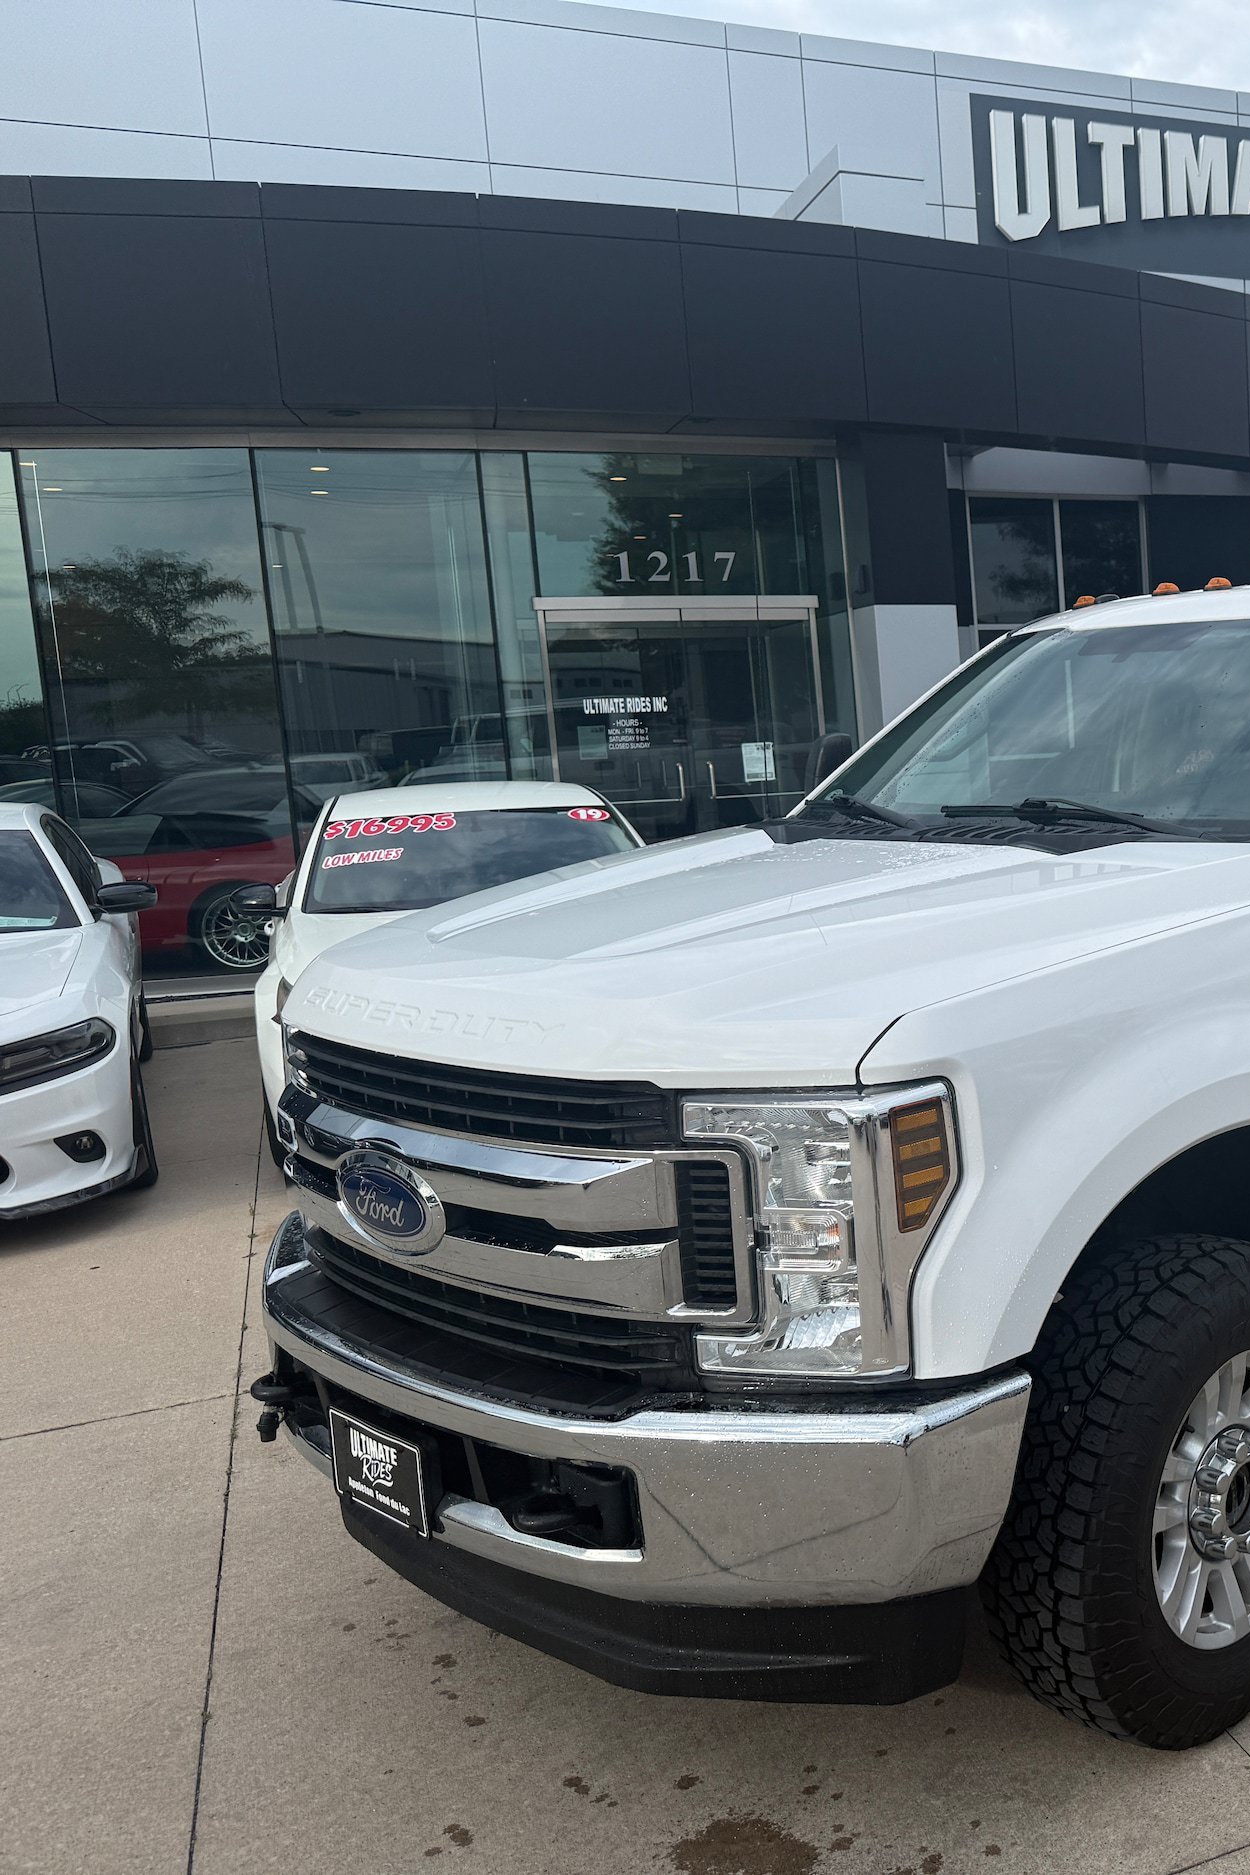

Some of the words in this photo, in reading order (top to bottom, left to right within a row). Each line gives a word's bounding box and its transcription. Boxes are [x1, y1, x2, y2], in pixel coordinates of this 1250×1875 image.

[613, 551, 736, 582] 1217
[583, 698, 625, 715] ULTIMATE
[627, 697, 651, 713] RIDES
[653, 696, 668, 712] INC
[616, 719, 639, 727] HOURS
[324, 812, 456, 840] $16995
[577, 808, 602, 819] 19
[322, 853, 356, 869] LOW
[356, 848, 404, 864] MILES
[303, 986, 422, 1029] SUPER
[426, 1009, 566, 1043] DUTY
[354, 1174, 405, 1227] Ford
[349, 1427, 398, 1467] ULTIMATE
[360, 1454, 393, 1484] RIDES
[348, 1476, 375, 1498] Appleton
[390, 1499, 399, 1511] du
[399, 1502, 411, 1517] Lac
